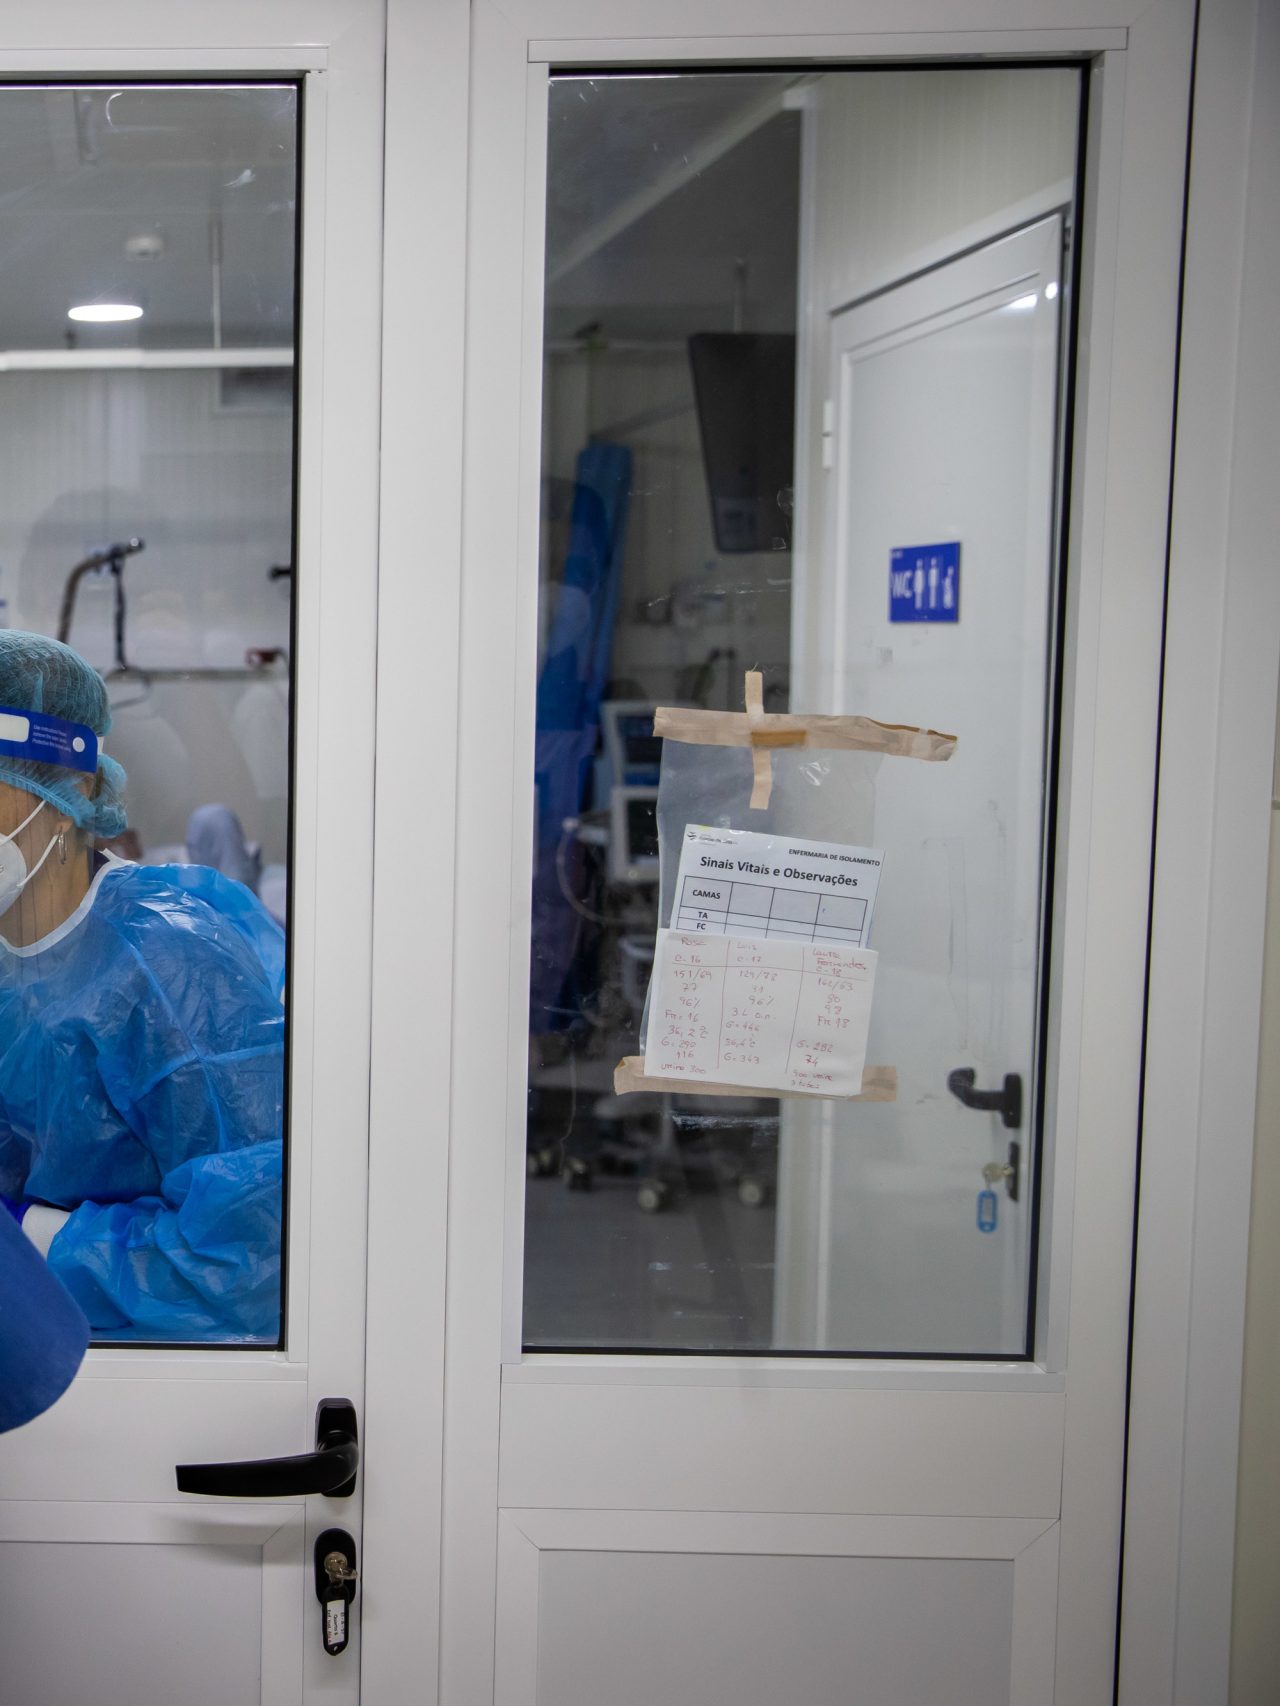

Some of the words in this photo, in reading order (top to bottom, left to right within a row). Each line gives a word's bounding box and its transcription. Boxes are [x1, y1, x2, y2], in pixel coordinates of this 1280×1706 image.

[891, 570, 912, 599] WC
[788, 848, 829, 860] ENFERMARIA
[839, 855, 880, 867] ISOLAMENTO
[700, 856, 734, 871] Sinais
[737, 861, 770, 875] Vitais
[773, 868, 780, 876] e
[783, 867, 858, 887] Observações
[692, 889, 721, 900] CAMAS
[698, 911, 708, 920] TA
[696, 922, 706, 931] FC
